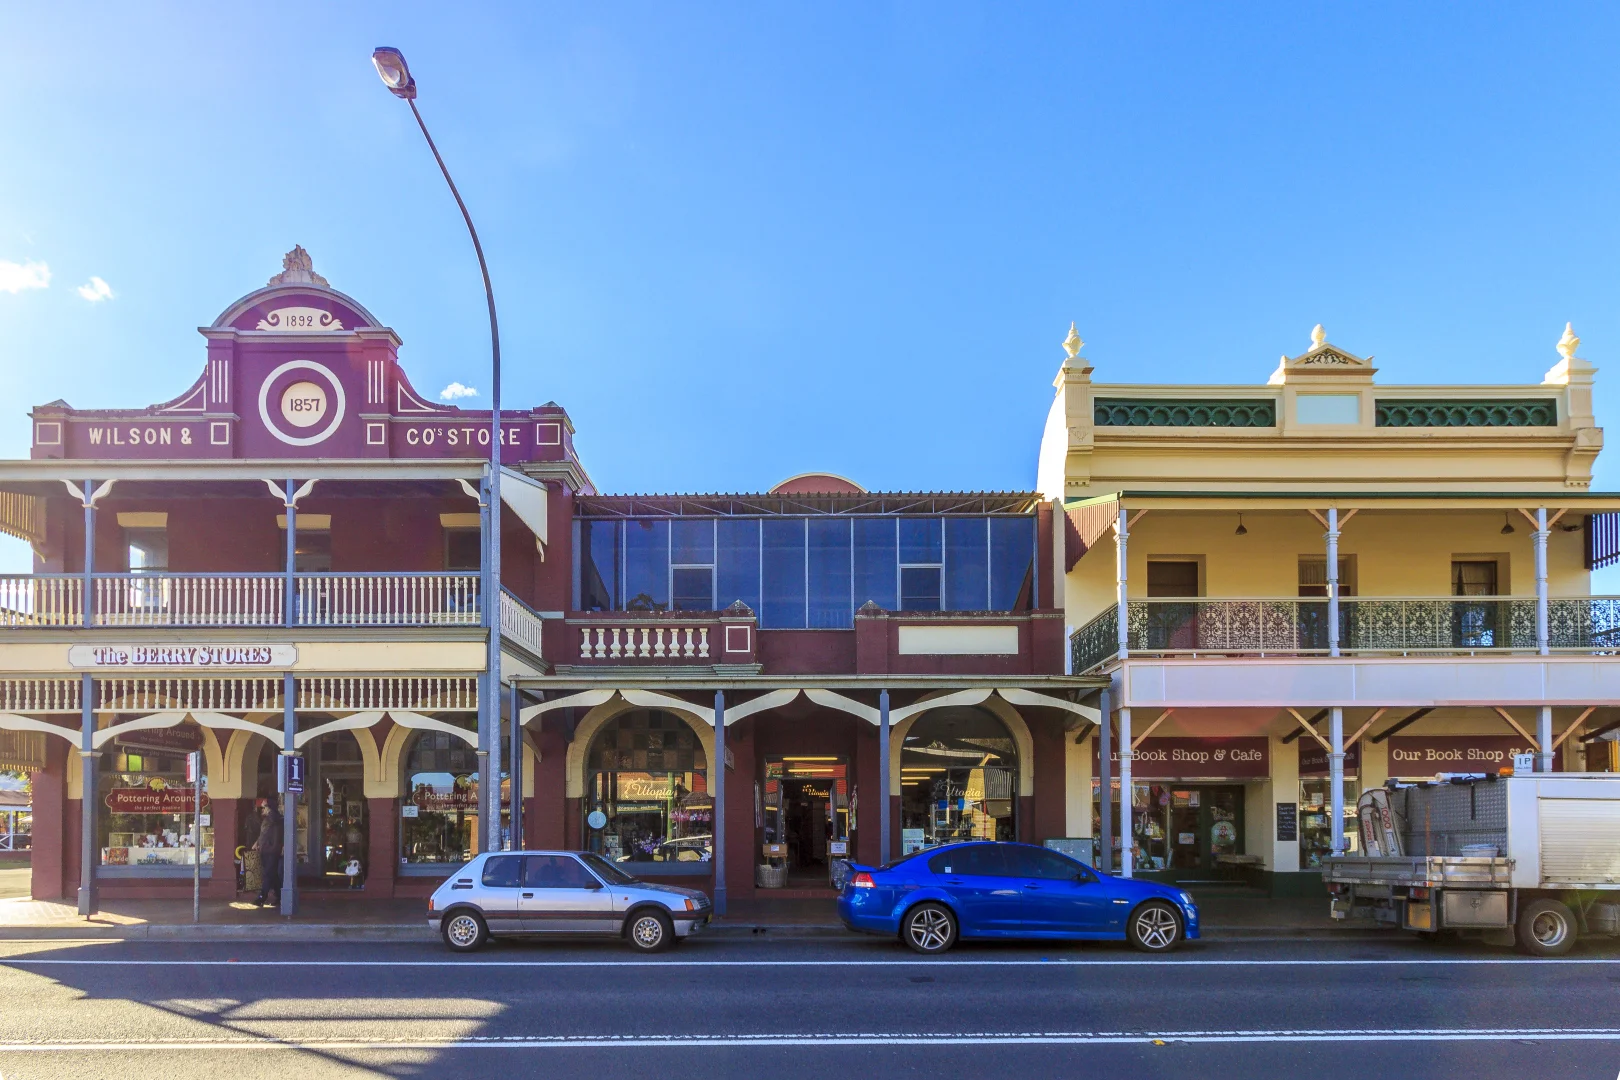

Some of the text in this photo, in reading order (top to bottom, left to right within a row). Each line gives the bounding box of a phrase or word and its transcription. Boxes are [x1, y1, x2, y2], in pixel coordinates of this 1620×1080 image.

[286, 315, 313, 327] 1892
[290, 398, 320, 412] 1857
[88, 427, 192, 445] WILSON &
[93, 645, 272, 665] The BERRY STORES
[1130, 750, 1167, 761] Book
[1172, 749, 1209, 763] Shop
[1213, 750, 1226, 761] &
[1230, 749, 1262, 761] Cafe
[1392, 748, 1421, 761] Our
[1425, 748, 1463, 761] Book
[1467, 748, 1504, 763] Shop
[424, 791, 468, 802] Pottering
[632, 782, 674, 799] Utopia
[941, 784, 983, 800] Utopia
[117, 794, 160, 804] Pottering
